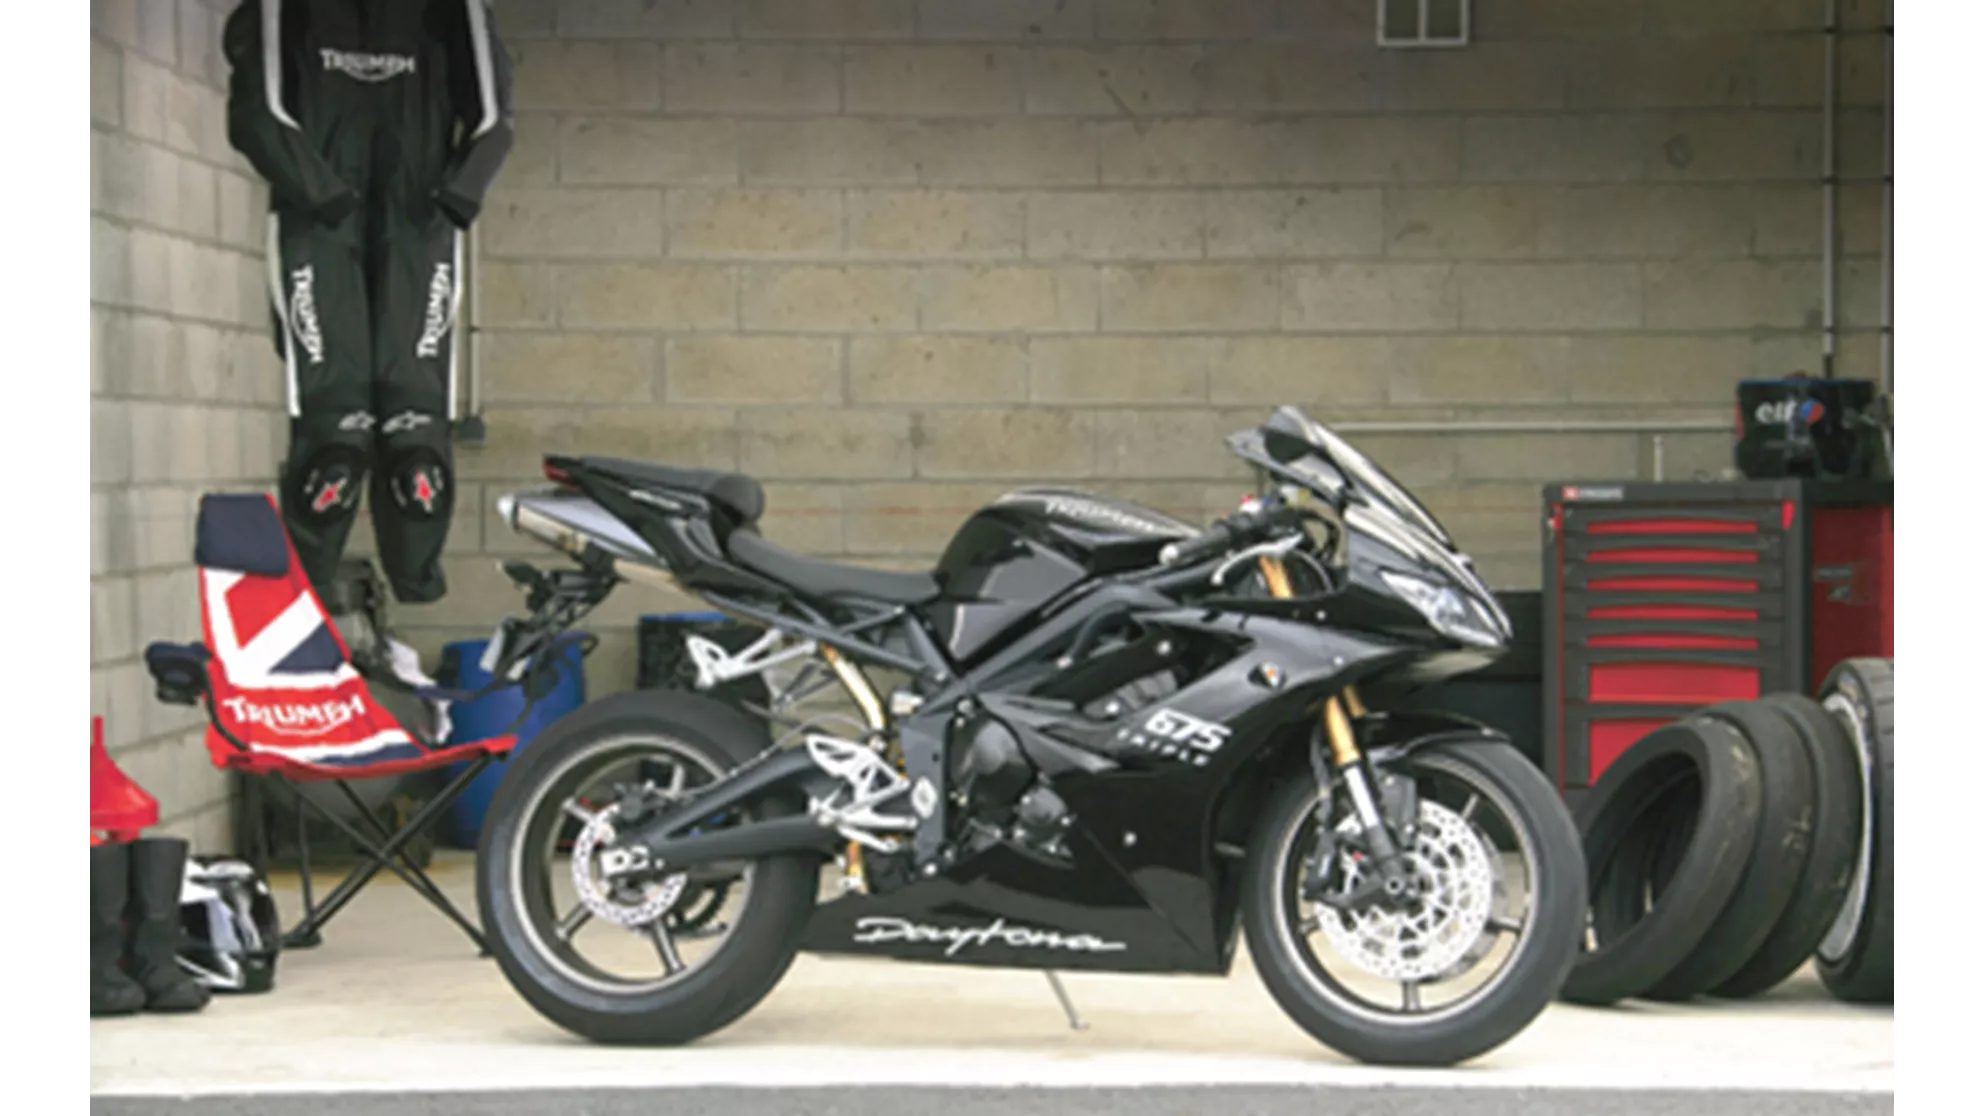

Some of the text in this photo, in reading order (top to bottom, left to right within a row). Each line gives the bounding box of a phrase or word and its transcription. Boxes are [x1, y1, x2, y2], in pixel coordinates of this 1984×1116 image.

[319, 47, 416, 81] TRIUMPH
[290, 264, 325, 363] TRIUMPH
[416, 261, 453, 358] TRIUMPH
[1754, 394, 1799, 424] elf
[221, 693, 367, 737] TRIUMPH
[1143, 707, 1233, 753] 675
[852, 915, 1128, 957] Daytona
